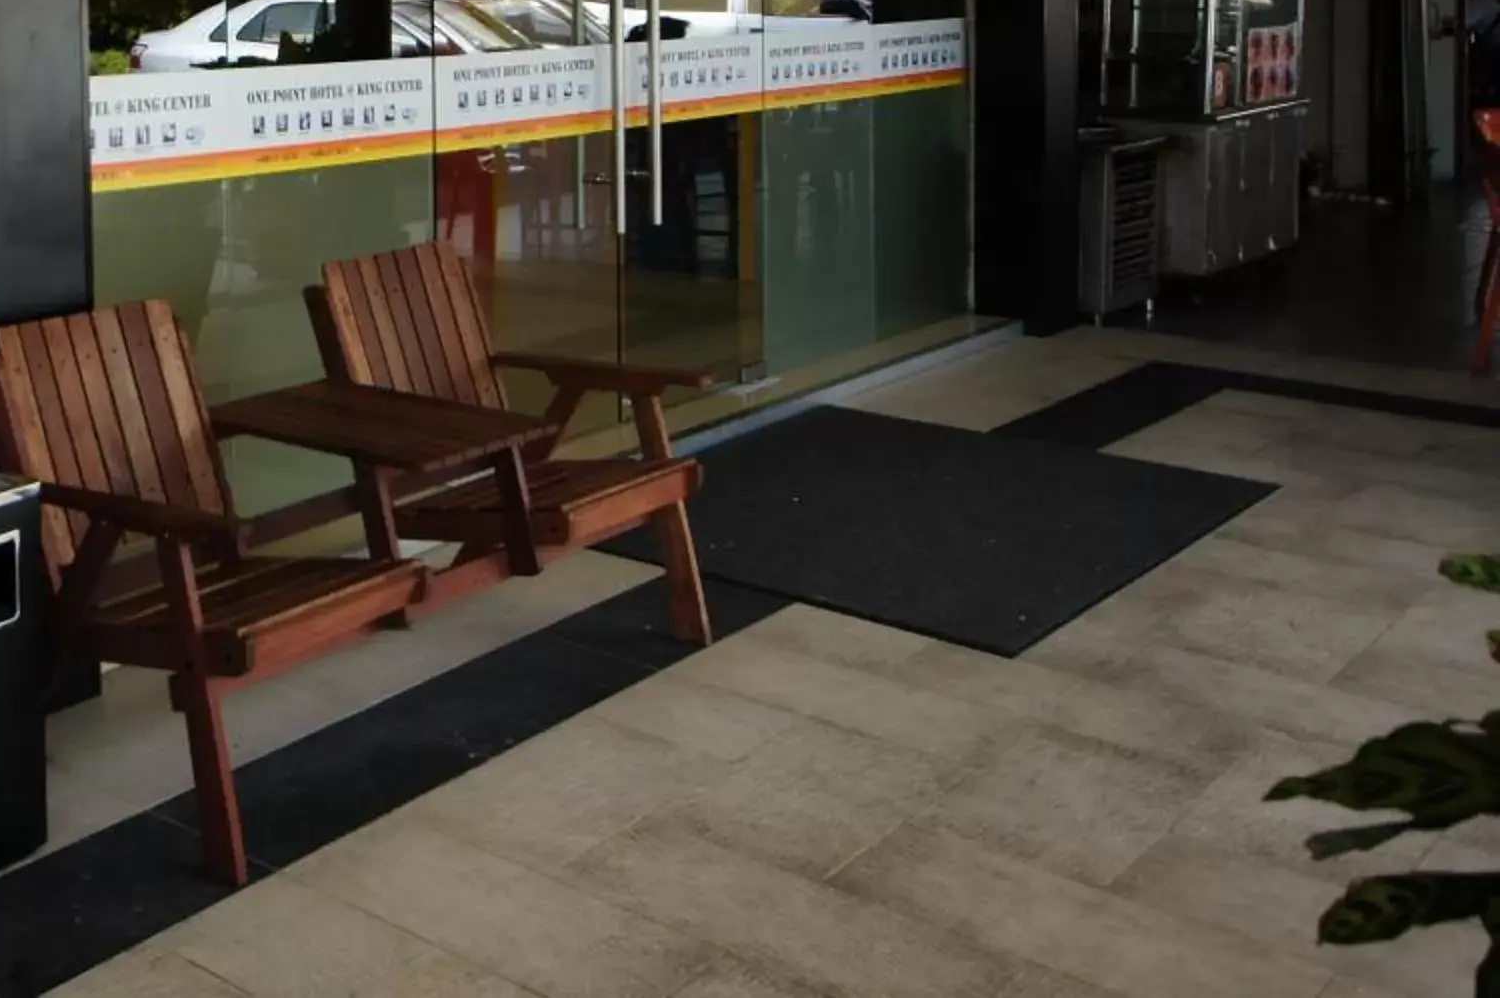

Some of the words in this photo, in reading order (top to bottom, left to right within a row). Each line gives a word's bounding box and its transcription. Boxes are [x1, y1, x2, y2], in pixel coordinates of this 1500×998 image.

[246, 89, 272, 104] ONE
[273, 86, 306, 103] POINT
[309, 83, 344, 100] HOTEL
[357, 81, 383, 96] KING
[384, 78, 423, 93] CENTER
[91, 100, 110, 117] EL
[126, 96, 162, 114] KING
[162, 93, 212, 112] CENTER
